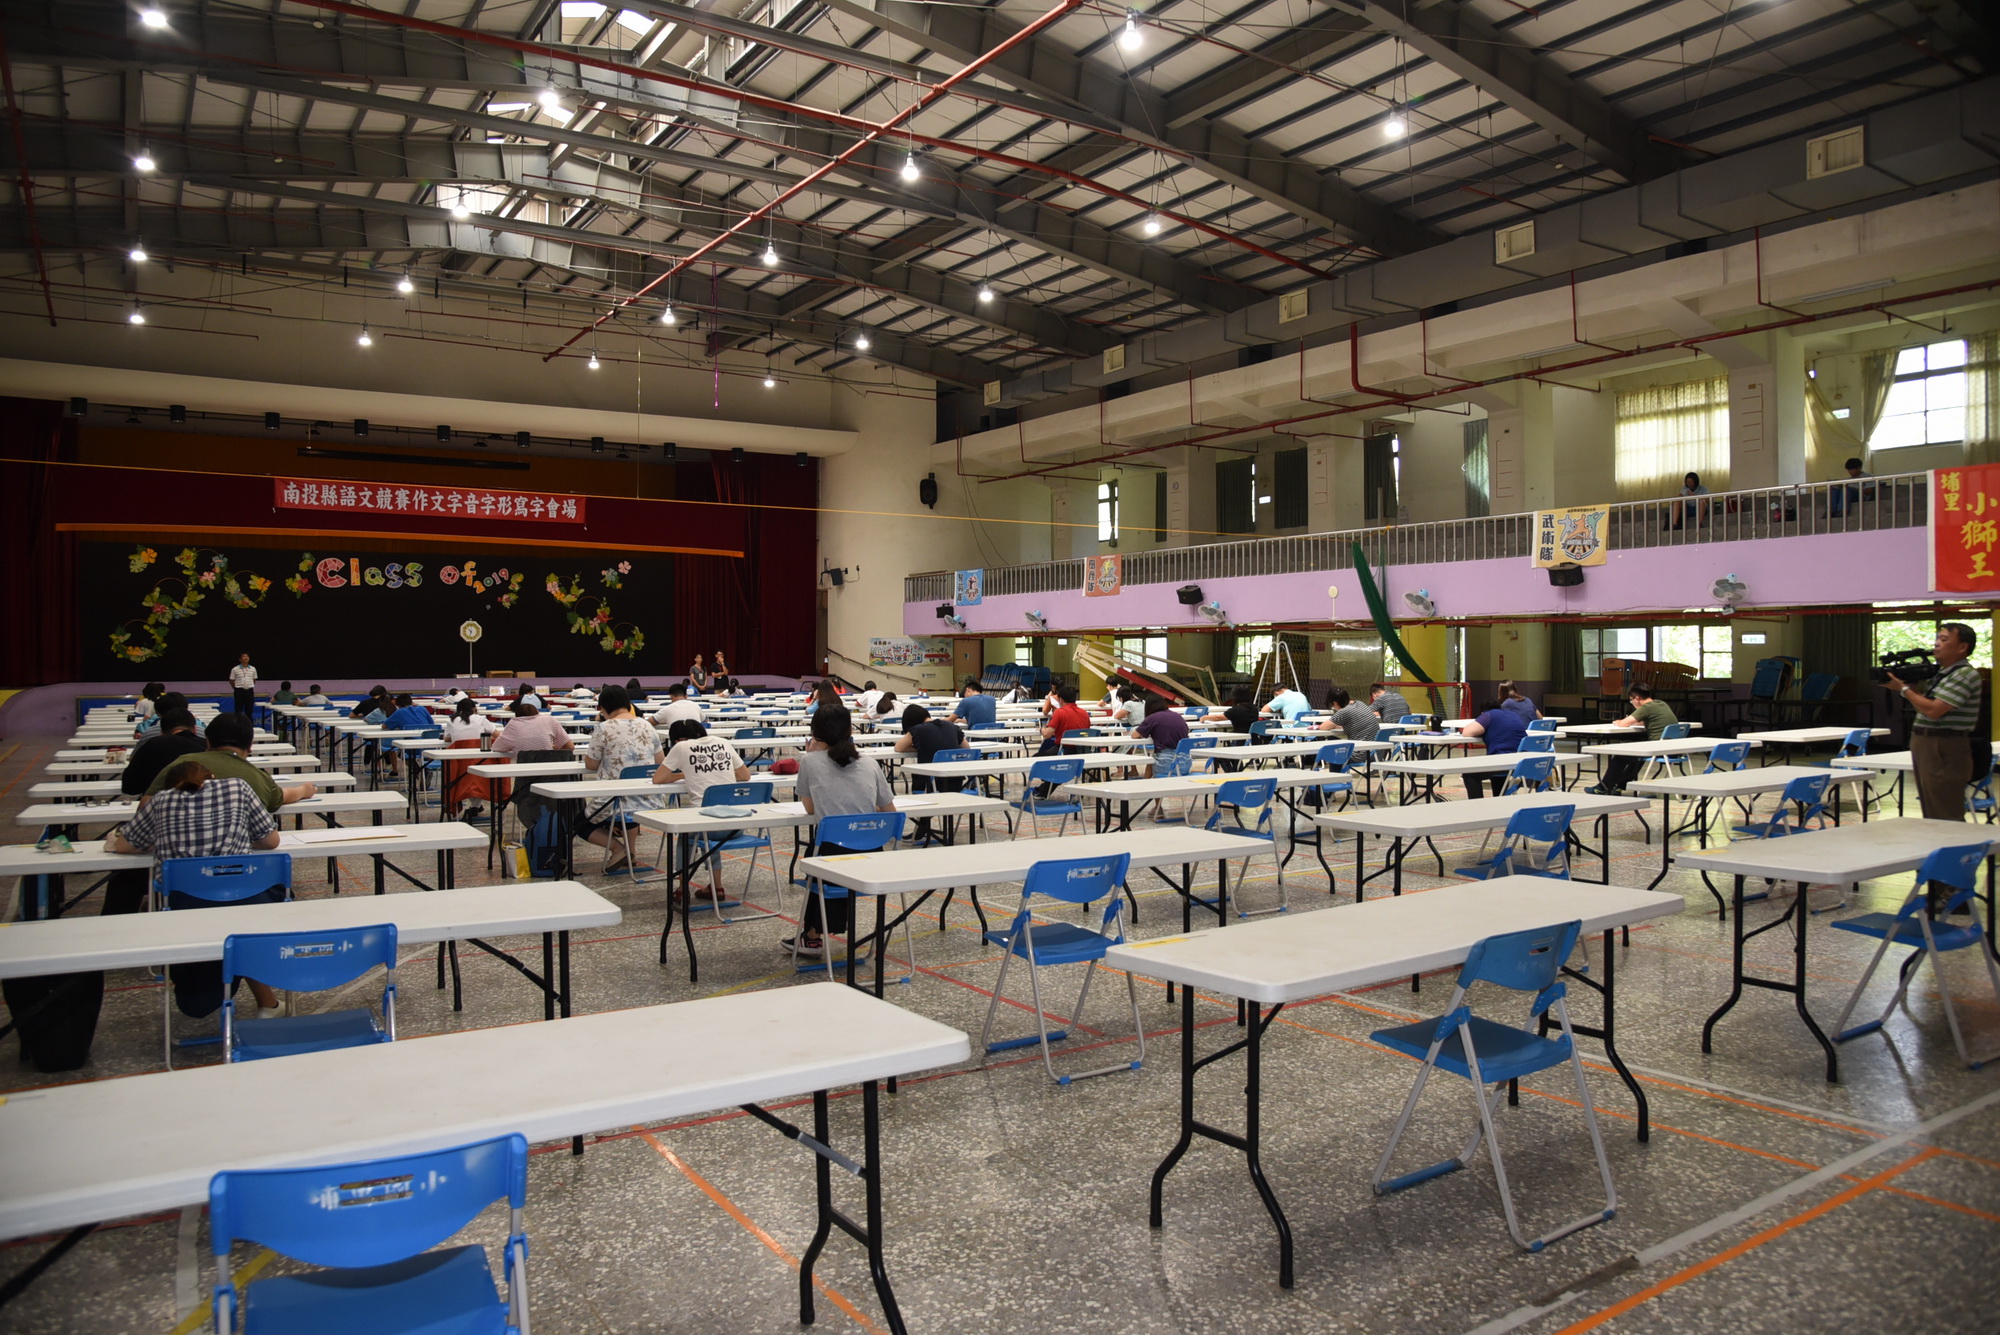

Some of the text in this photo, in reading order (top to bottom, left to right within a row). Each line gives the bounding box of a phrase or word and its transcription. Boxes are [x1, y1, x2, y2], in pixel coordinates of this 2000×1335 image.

[283, 481, 577, 519] 南投縣語文競賽作文字音字形寫字會場
[1941, 472, 1960, 511] 埔里
[1540, 514, 1554, 560] 武術隊
[1961, 492, 1998, 579] 小獅王
[315, 557, 509, 594] Class of 2019
[690, 744, 725, 753] WHICH
[694, 760, 730, 773] MAKE?
